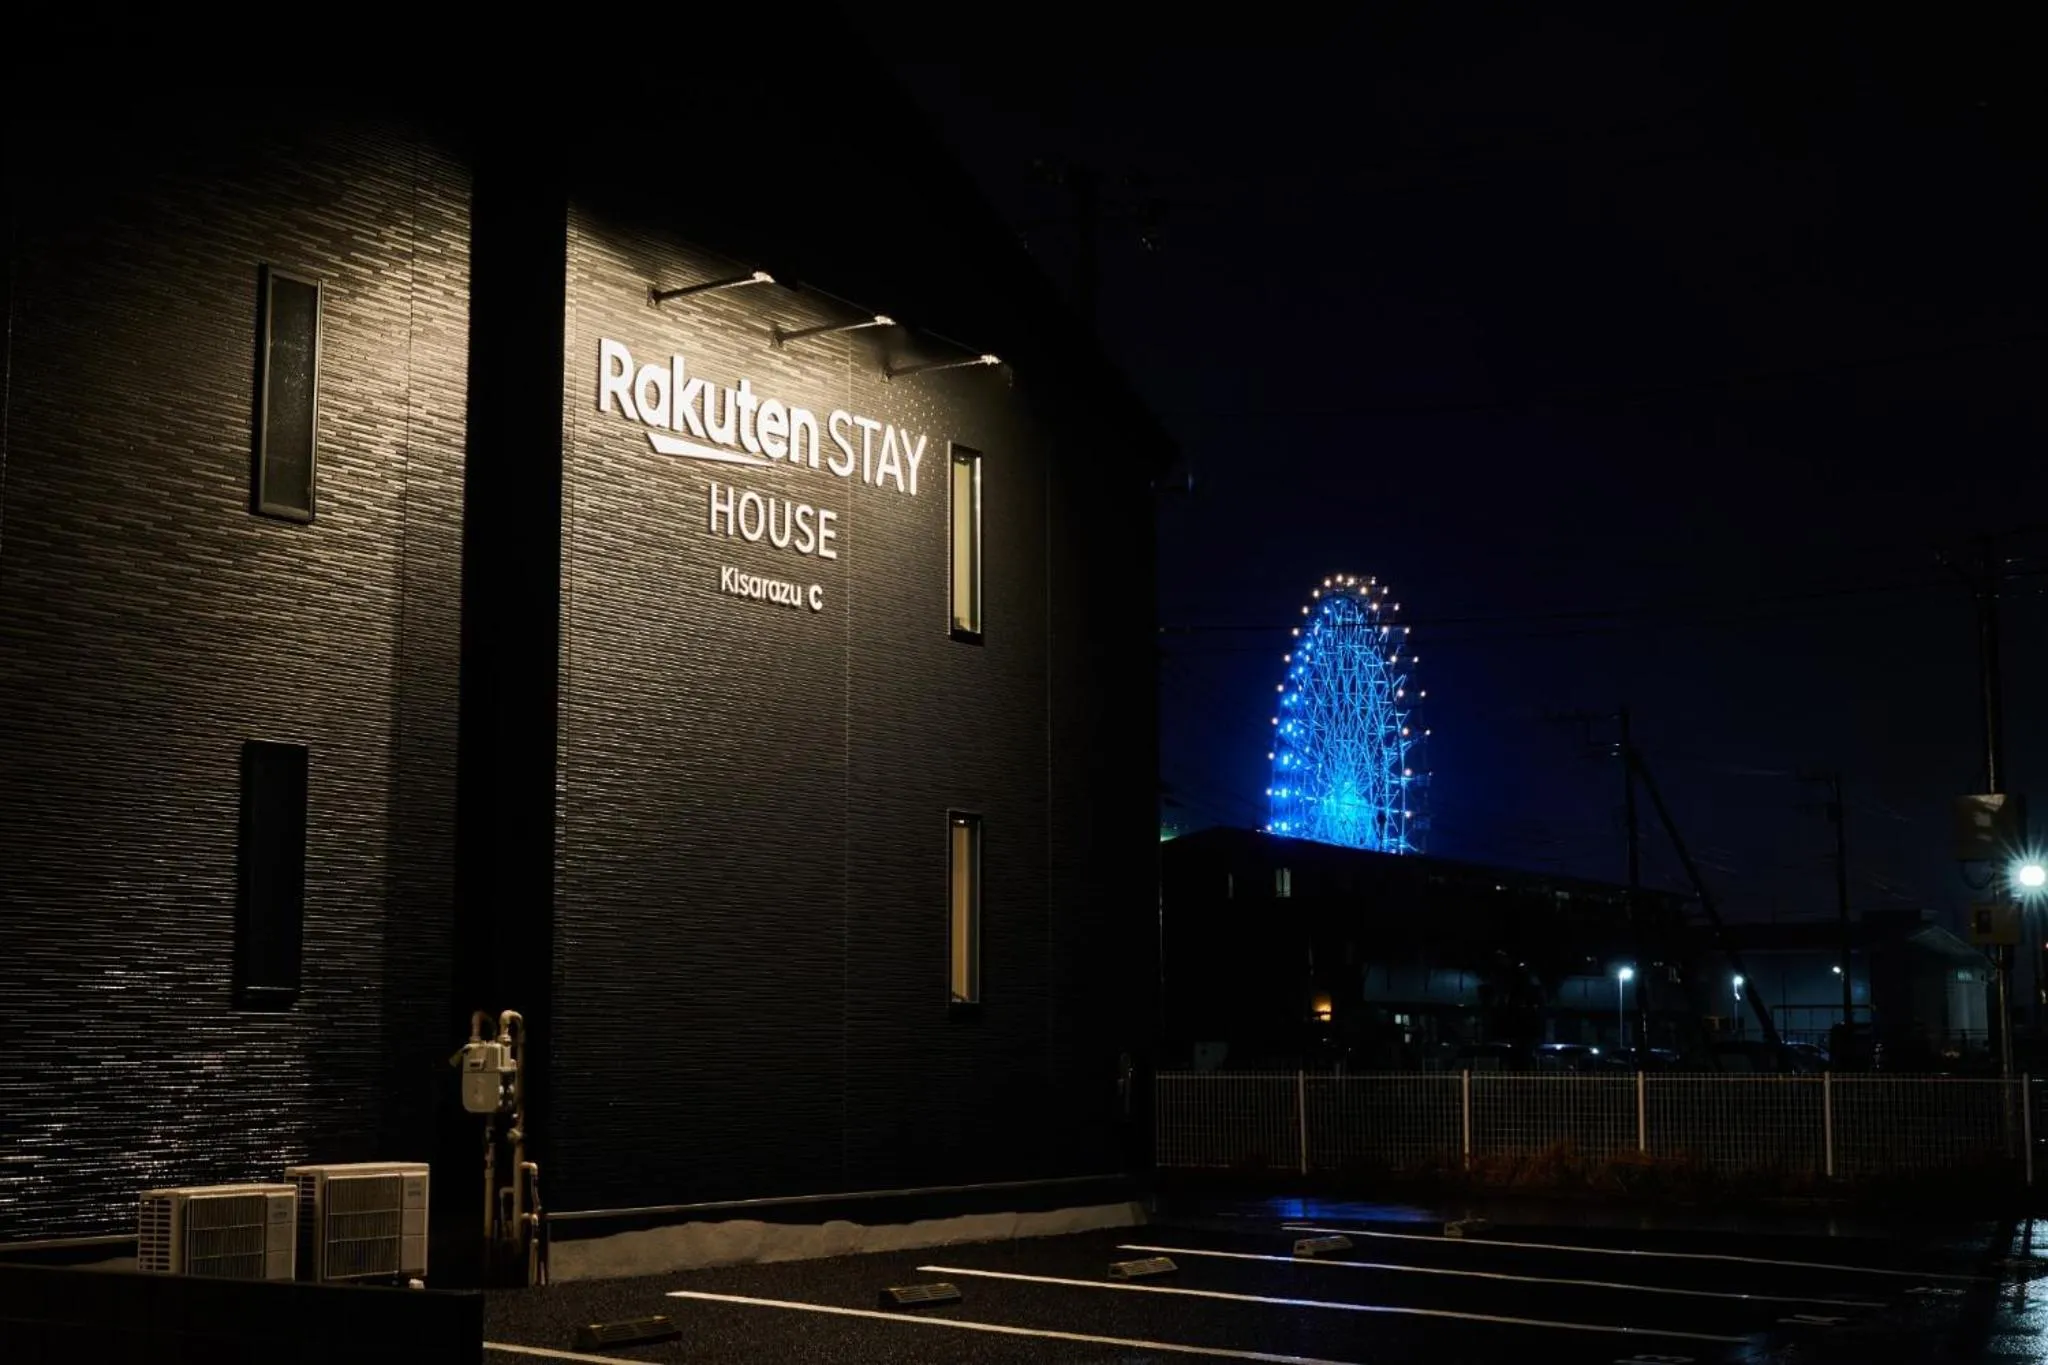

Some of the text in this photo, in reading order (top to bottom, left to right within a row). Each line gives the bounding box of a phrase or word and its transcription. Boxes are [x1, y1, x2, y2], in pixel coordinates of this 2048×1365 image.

[599, 338, 927, 496] Rakuten STAY
[710, 483, 838, 560] HOUSE
[721, 566, 823, 611] Kisarazu C
